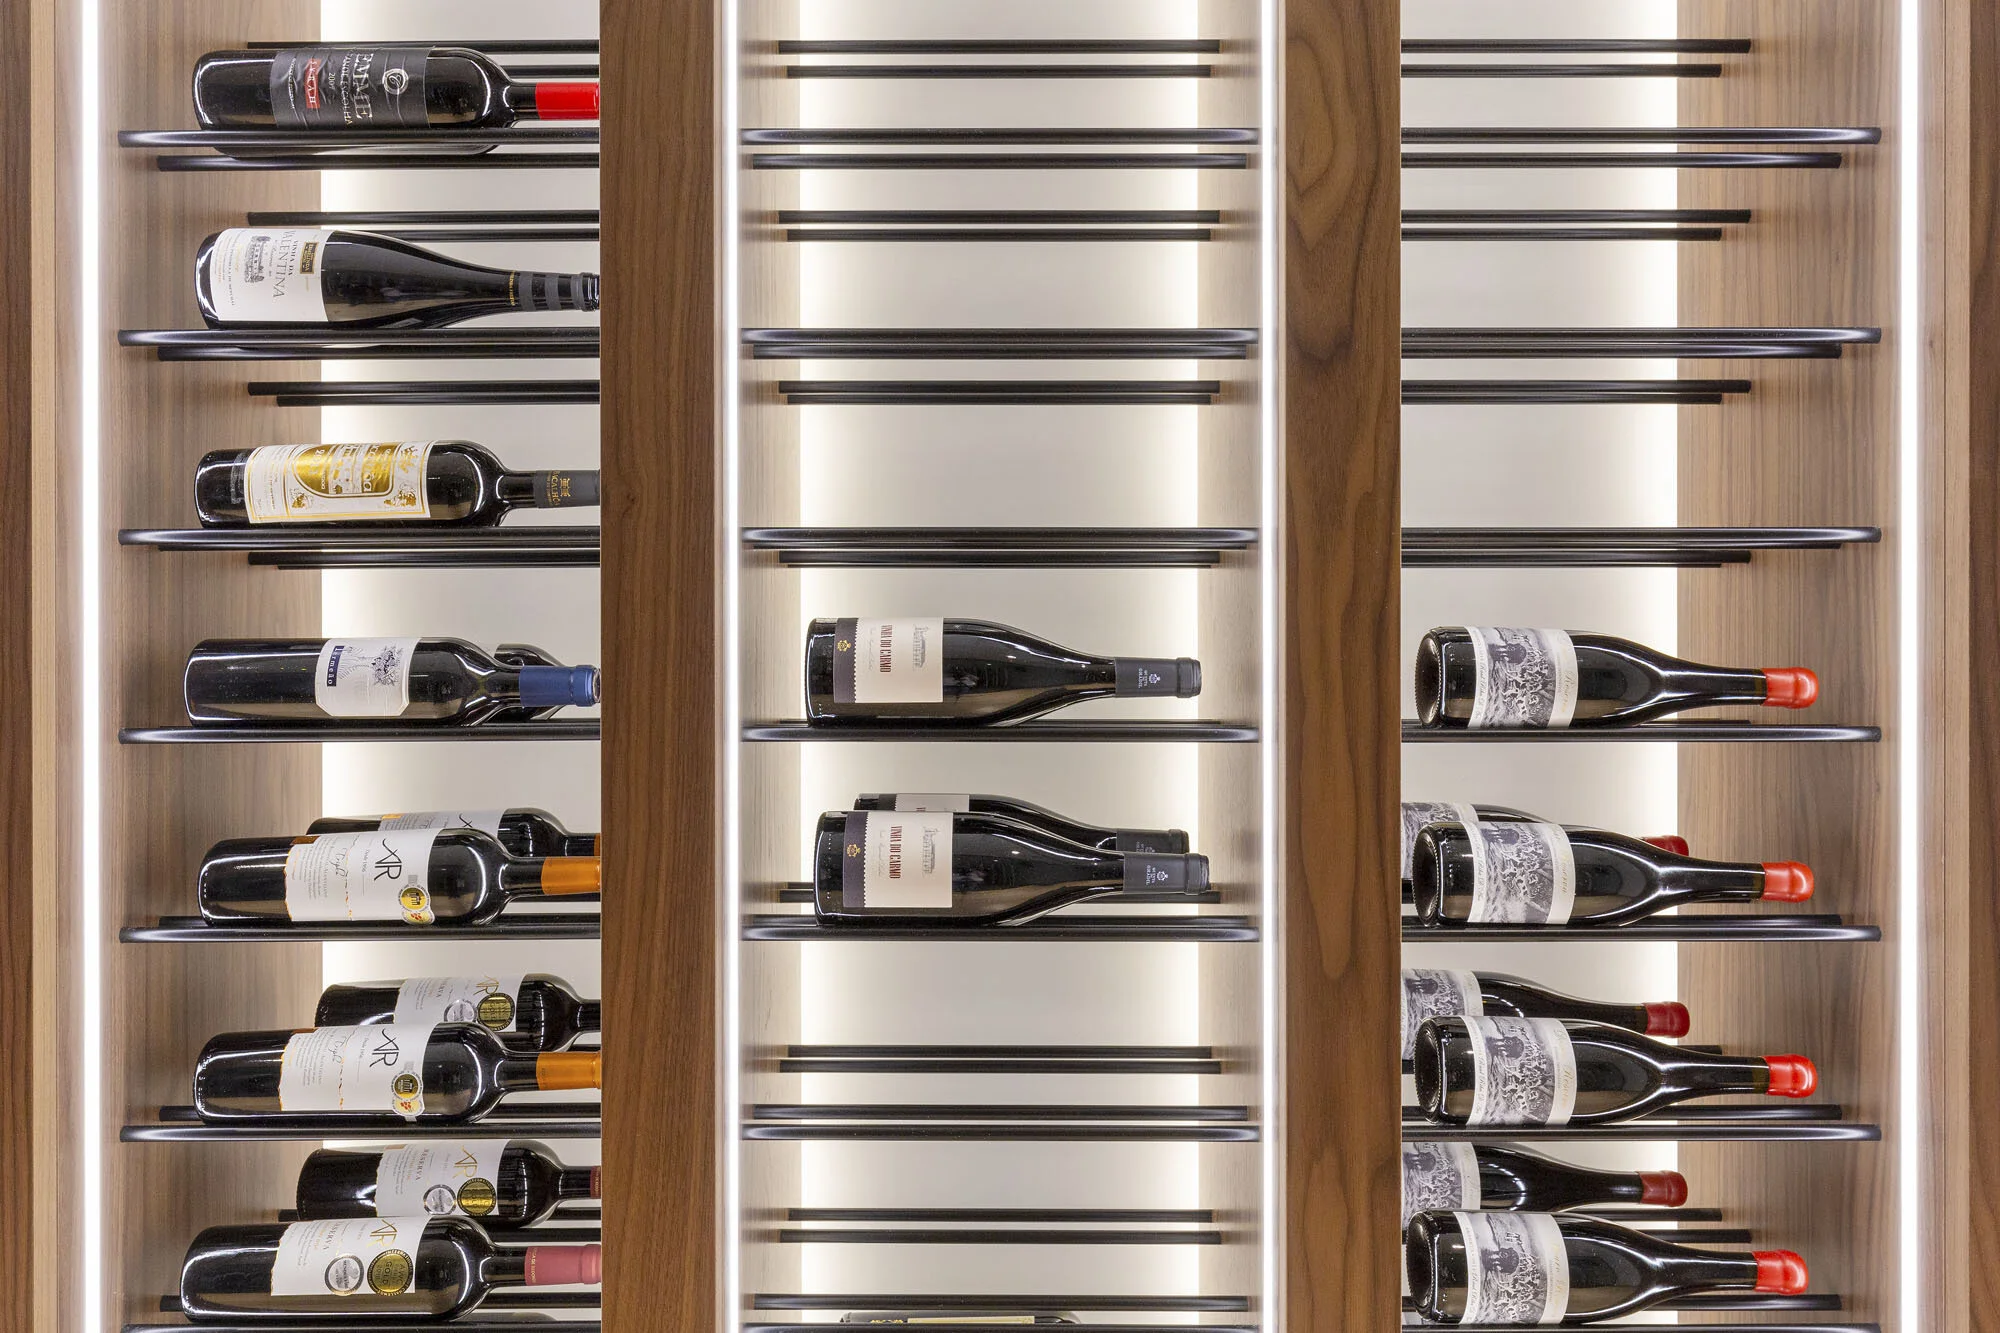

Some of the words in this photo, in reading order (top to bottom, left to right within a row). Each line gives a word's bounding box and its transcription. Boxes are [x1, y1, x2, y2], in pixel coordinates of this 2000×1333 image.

[289, 240, 298, 262] VINHA
[273, 230, 297, 298] VALENTINA
[288, 265, 294, 276] DA
[881, 625, 893, 639] VINHA
[880, 639, 892, 648] DO
[880, 649, 892, 673] CARMO
[890, 825, 903, 843] VINHA
[890, 843, 902, 853] DO
[889, 854, 902, 879] CARMO
